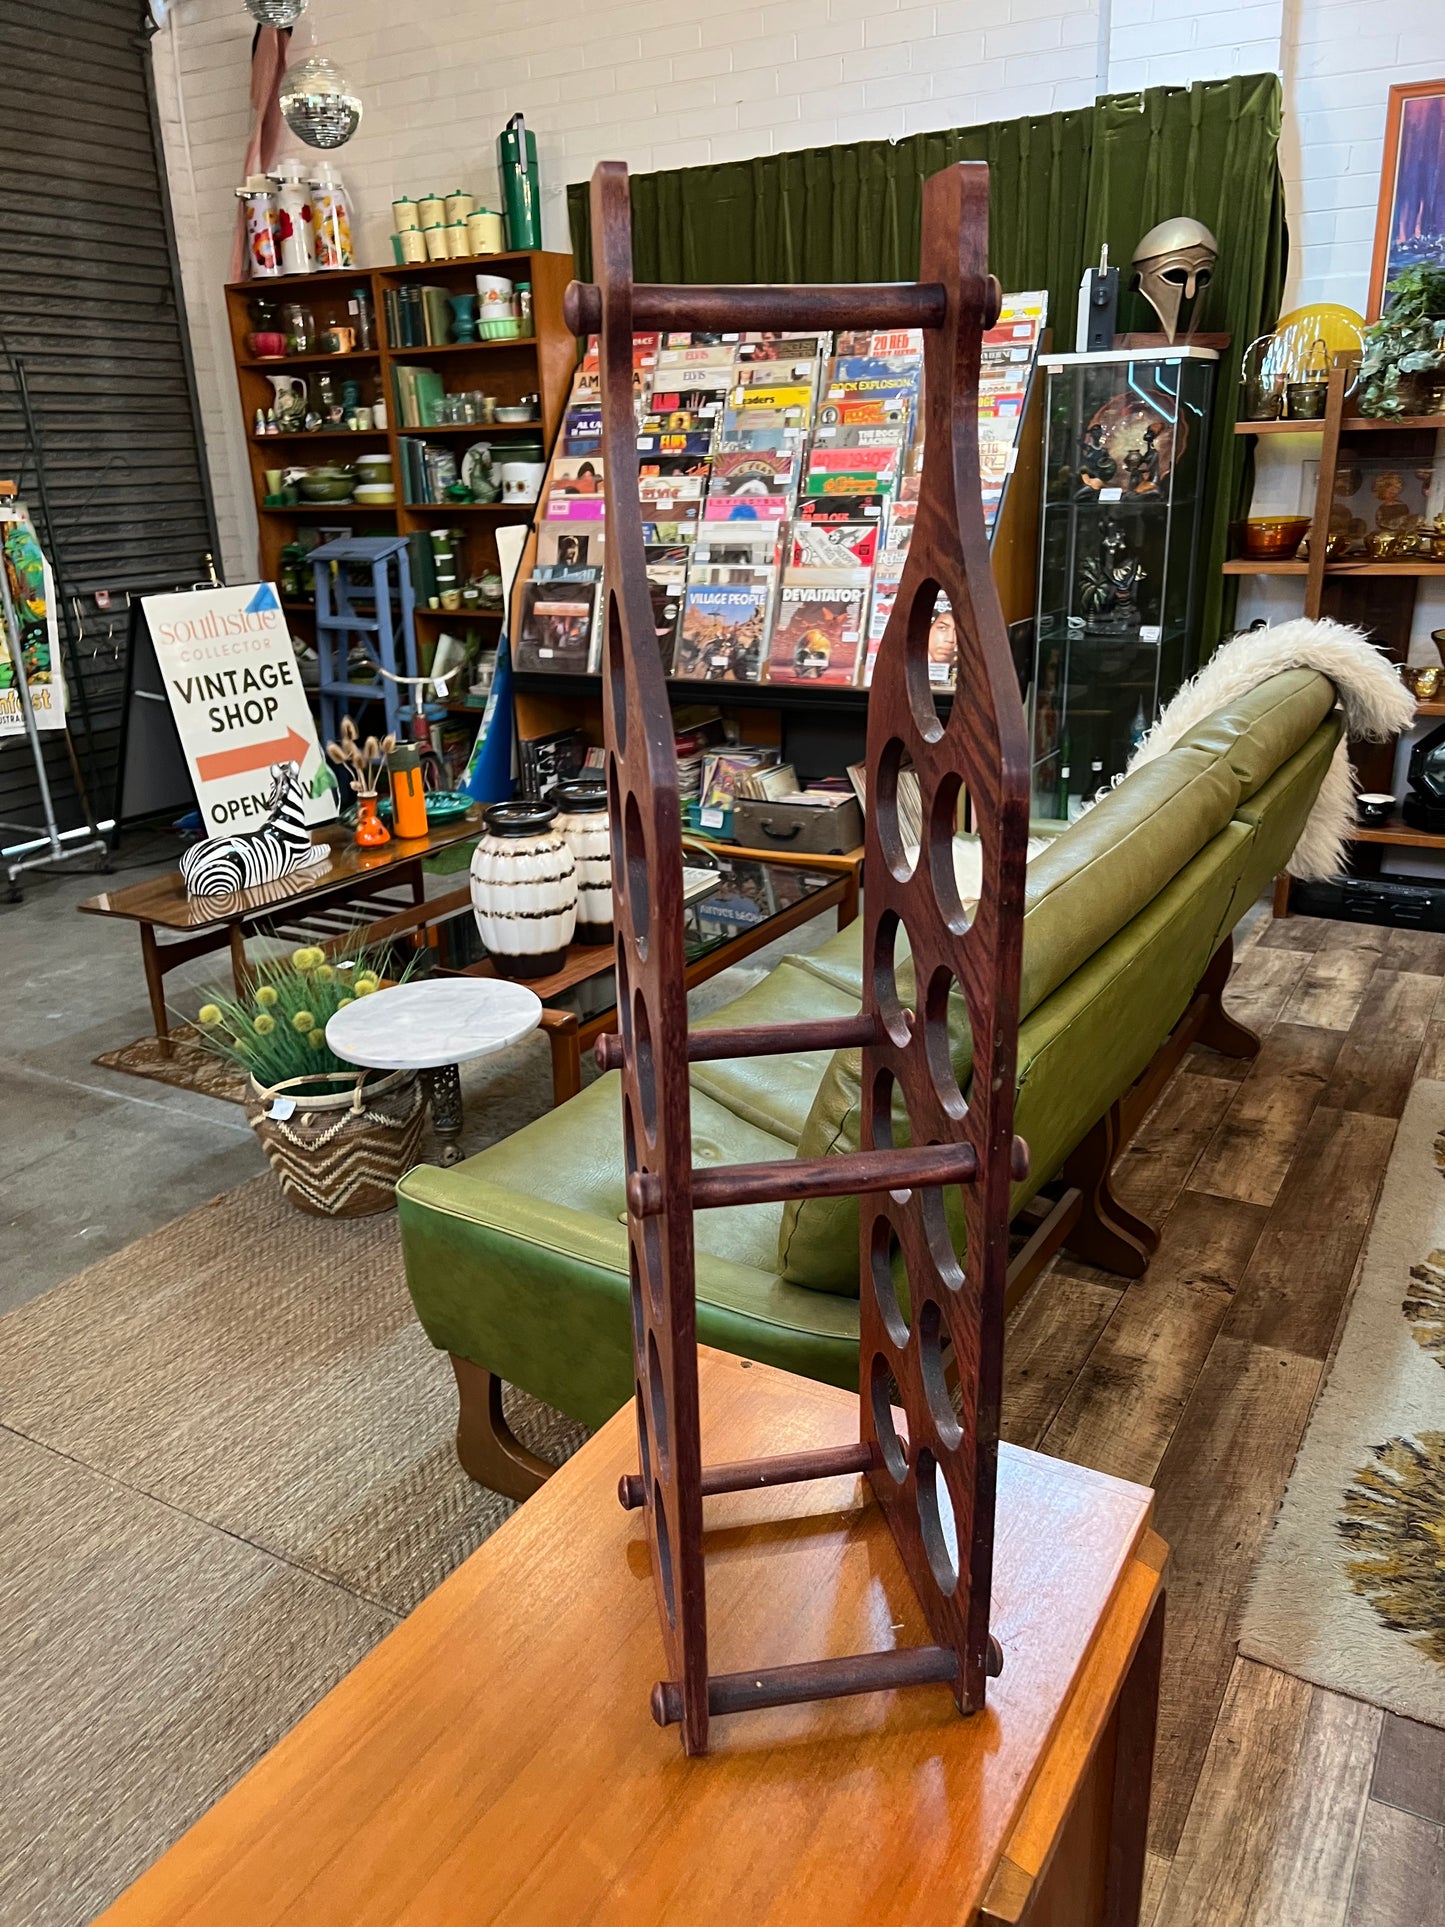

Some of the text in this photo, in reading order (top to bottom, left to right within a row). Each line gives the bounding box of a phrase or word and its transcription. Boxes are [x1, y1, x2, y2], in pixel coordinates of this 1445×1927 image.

[689, 592, 766, 606] VILLAGE PEOPLE
[158, 609, 277, 646] southside
[180, 638, 271, 663] COLLECTOR
[173, 661, 294, 704] VINTAGE
[208, 697, 279, 733] SHOP
[211, 792, 270, 824] OPEN
